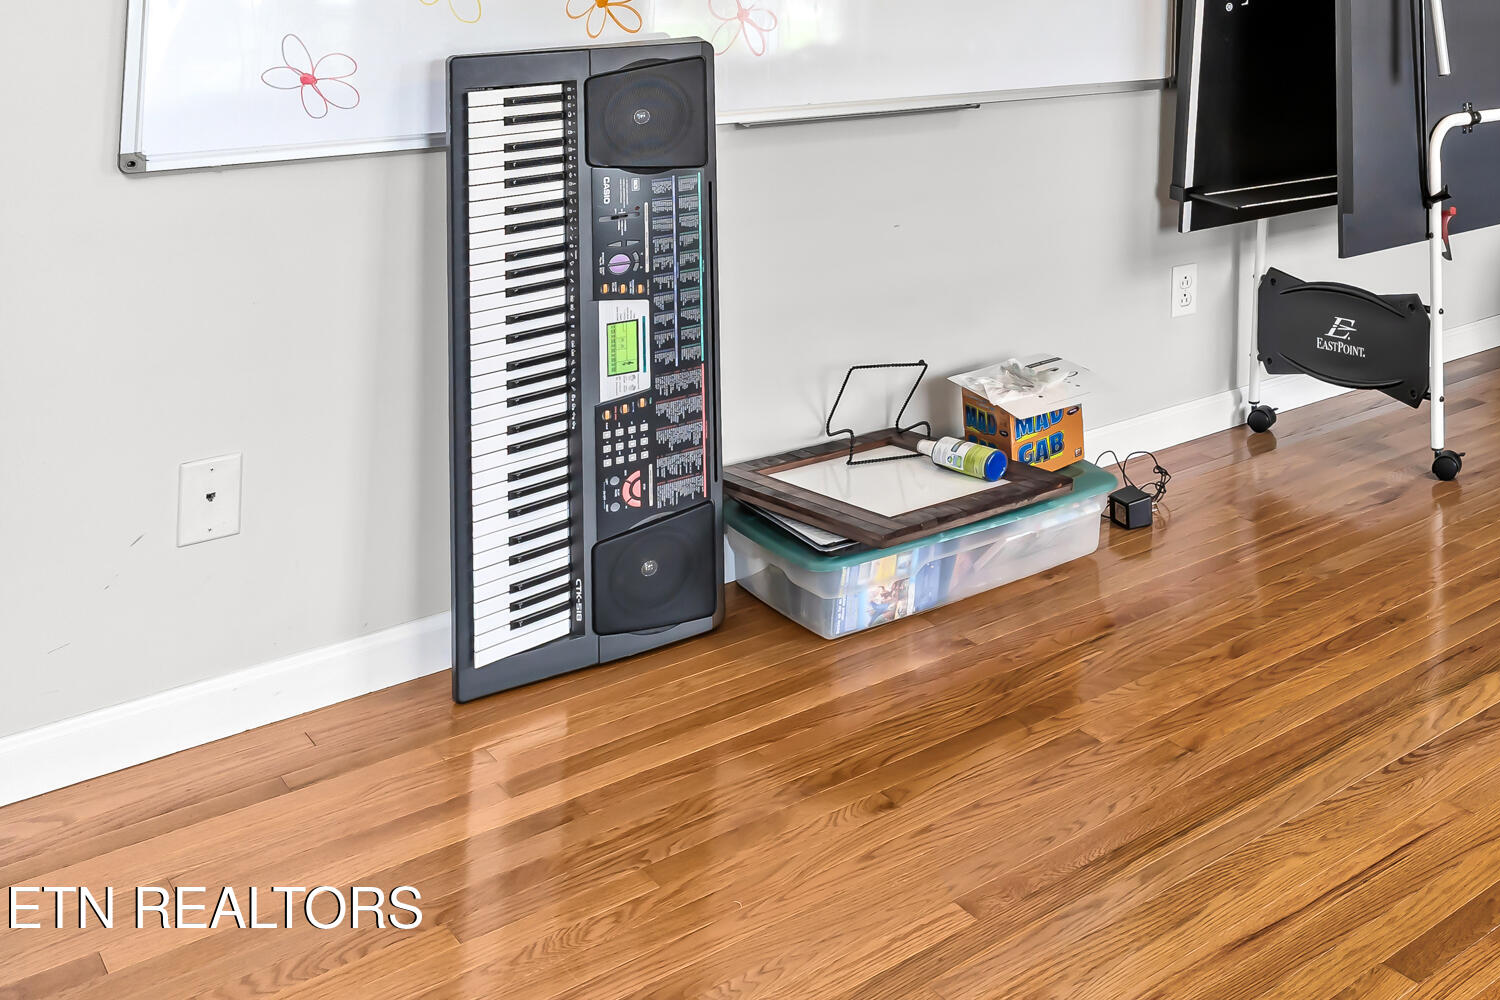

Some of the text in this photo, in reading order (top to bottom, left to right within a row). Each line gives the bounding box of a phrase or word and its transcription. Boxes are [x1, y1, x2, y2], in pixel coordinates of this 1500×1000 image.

[1015, 408, 1064, 440] MAD
[1018, 431, 1065, 465] GAB
[575, 578, 583, 622] CTK-518
